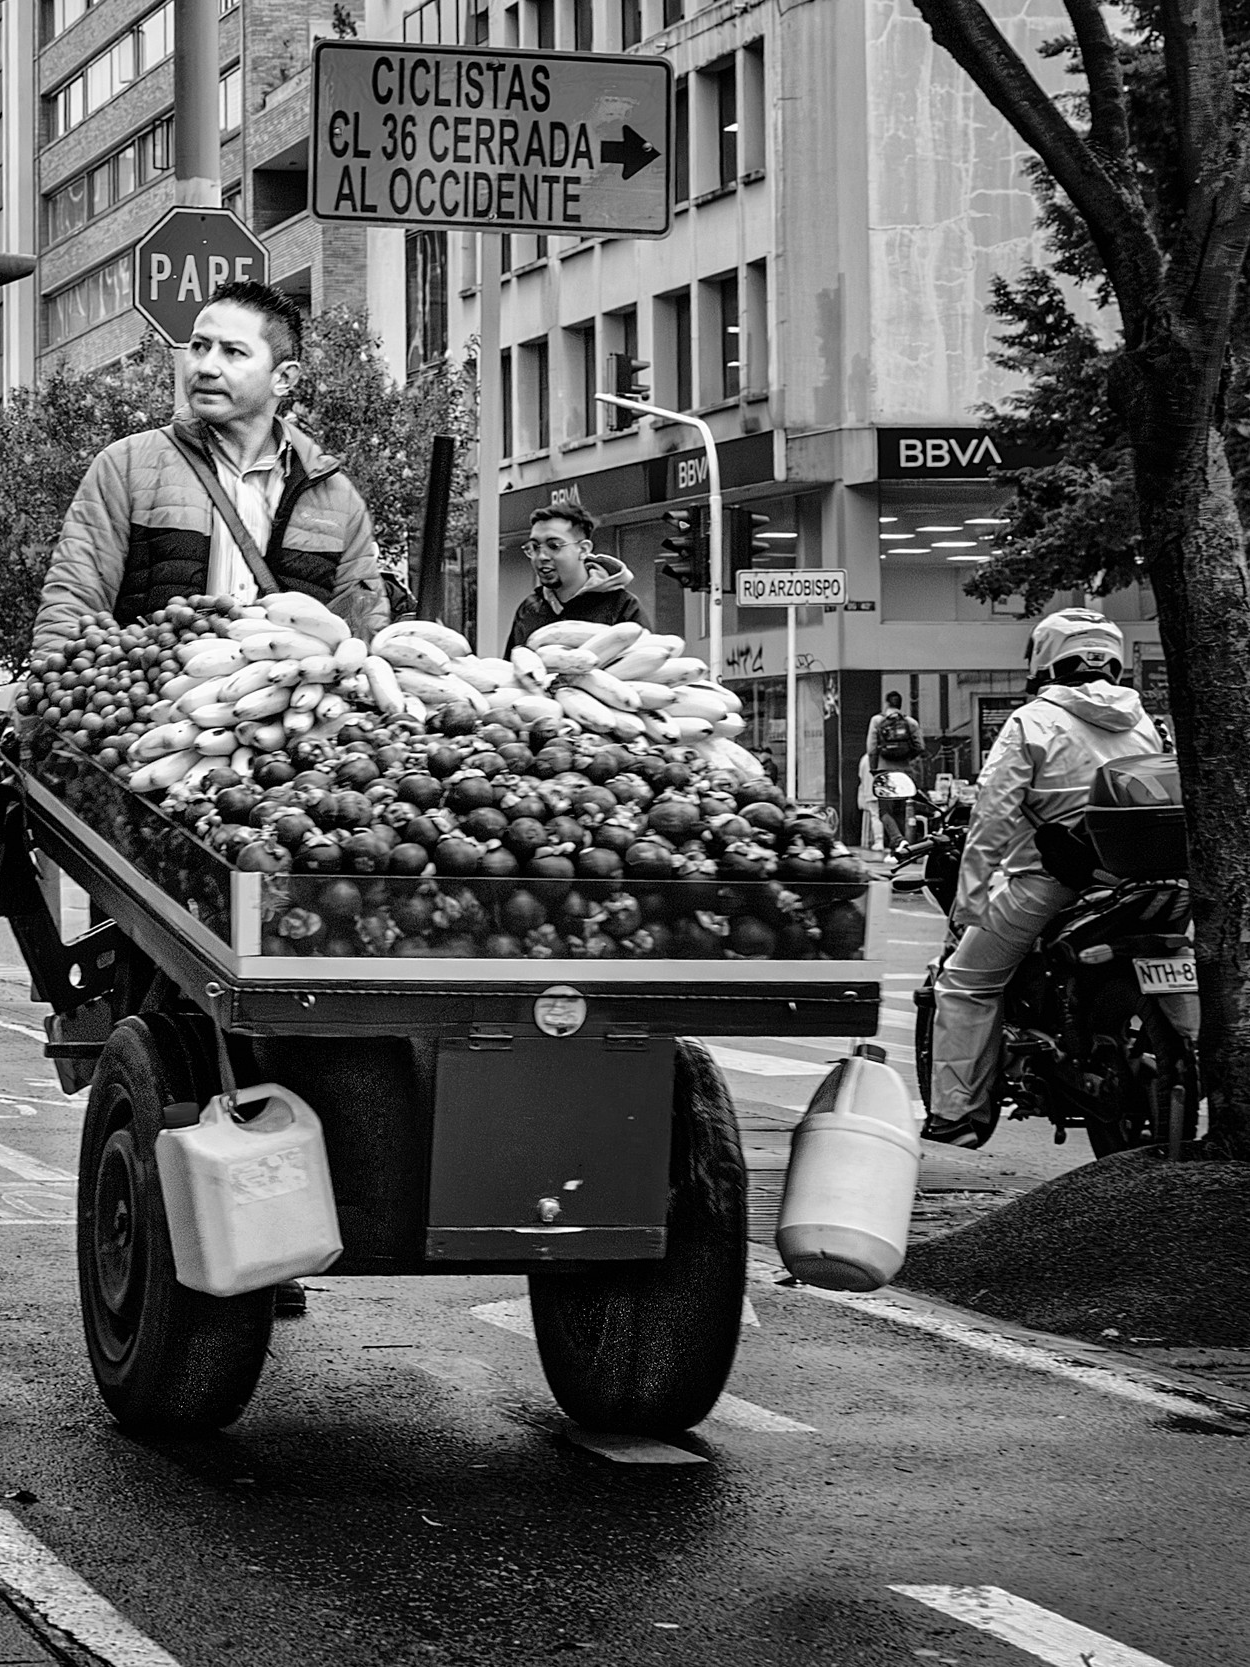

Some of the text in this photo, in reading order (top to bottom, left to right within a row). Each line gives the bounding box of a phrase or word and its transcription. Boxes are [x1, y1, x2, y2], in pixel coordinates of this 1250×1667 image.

[371, 56, 551, 113] CICLISTAS
[329, 110, 595, 170] CL 36 CERRADA
[334, 165, 582, 223] AL OCCIDENTE
[899, 435, 1003, 468] BBVA
[743, 579, 841, 598] RIO ARZOBISPO
